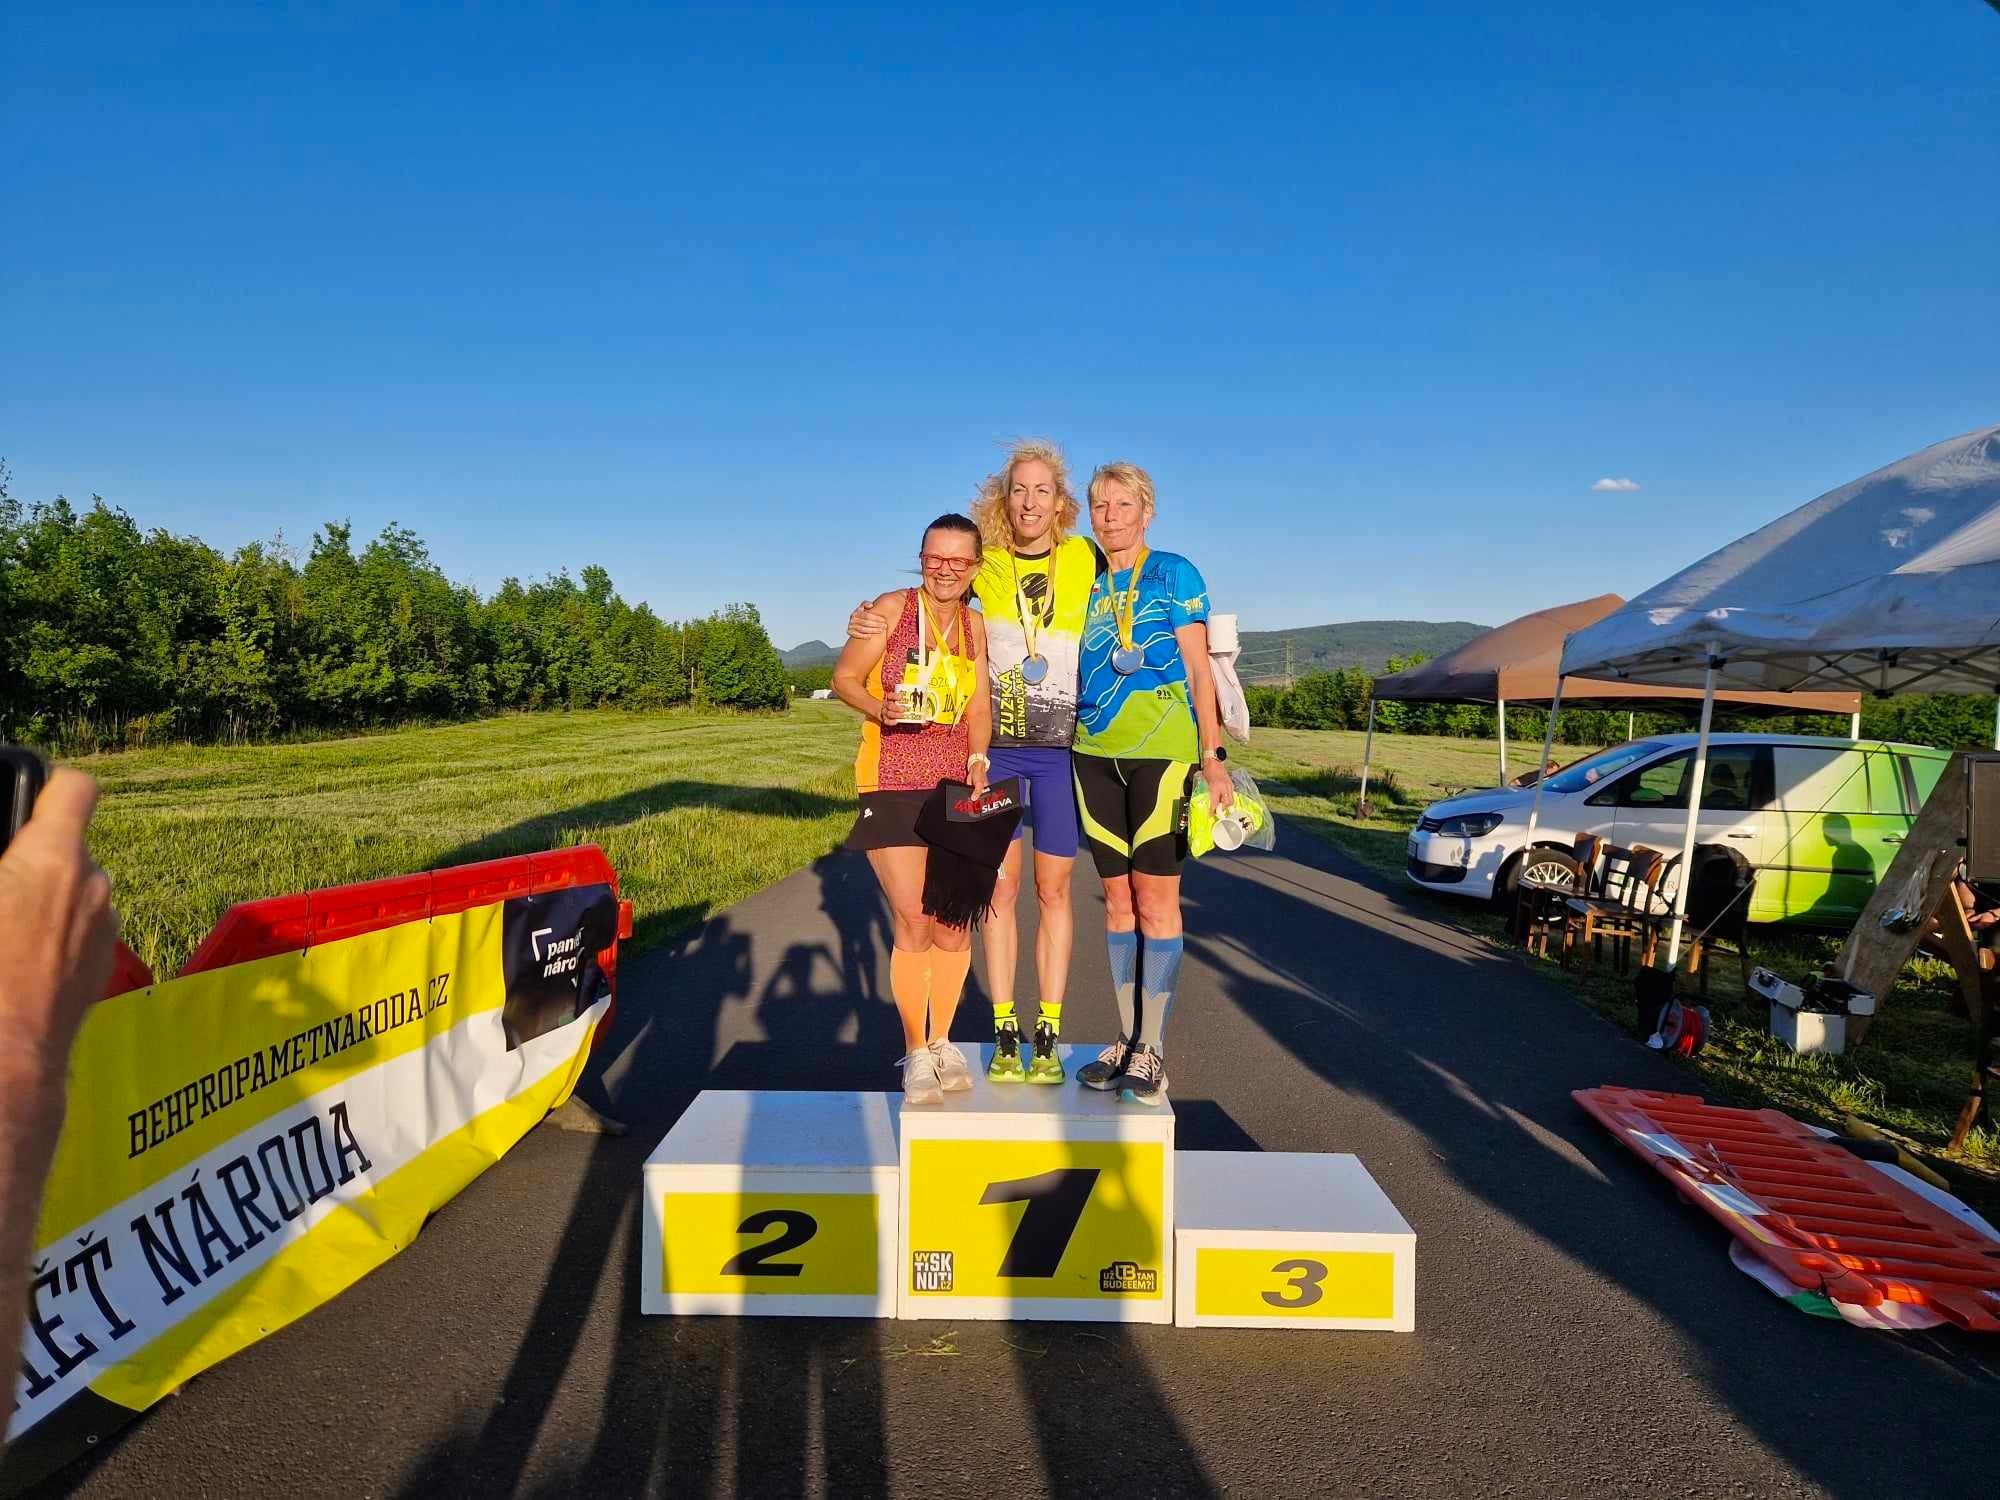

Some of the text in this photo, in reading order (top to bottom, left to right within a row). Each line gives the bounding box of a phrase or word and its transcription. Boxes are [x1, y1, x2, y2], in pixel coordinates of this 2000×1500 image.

[997, 669, 1015, 737] ZUZKA
[1016, 697, 1026, 718] NAD
[981, 797, 1013, 814] SLEVA
[543, 954, 580, 978] náro
[128, 973, 449, 1159] BEHPROPAMETNARODA.CZ
[130, 1101, 372, 1306] NÁRODA
[979, 1168, 1101, 1278] 1
[720, 1209, 818, 1277] 2
[1136, 1272, 1155, 1280] TAM
[1261, 1259, 1328, 1308] 3
